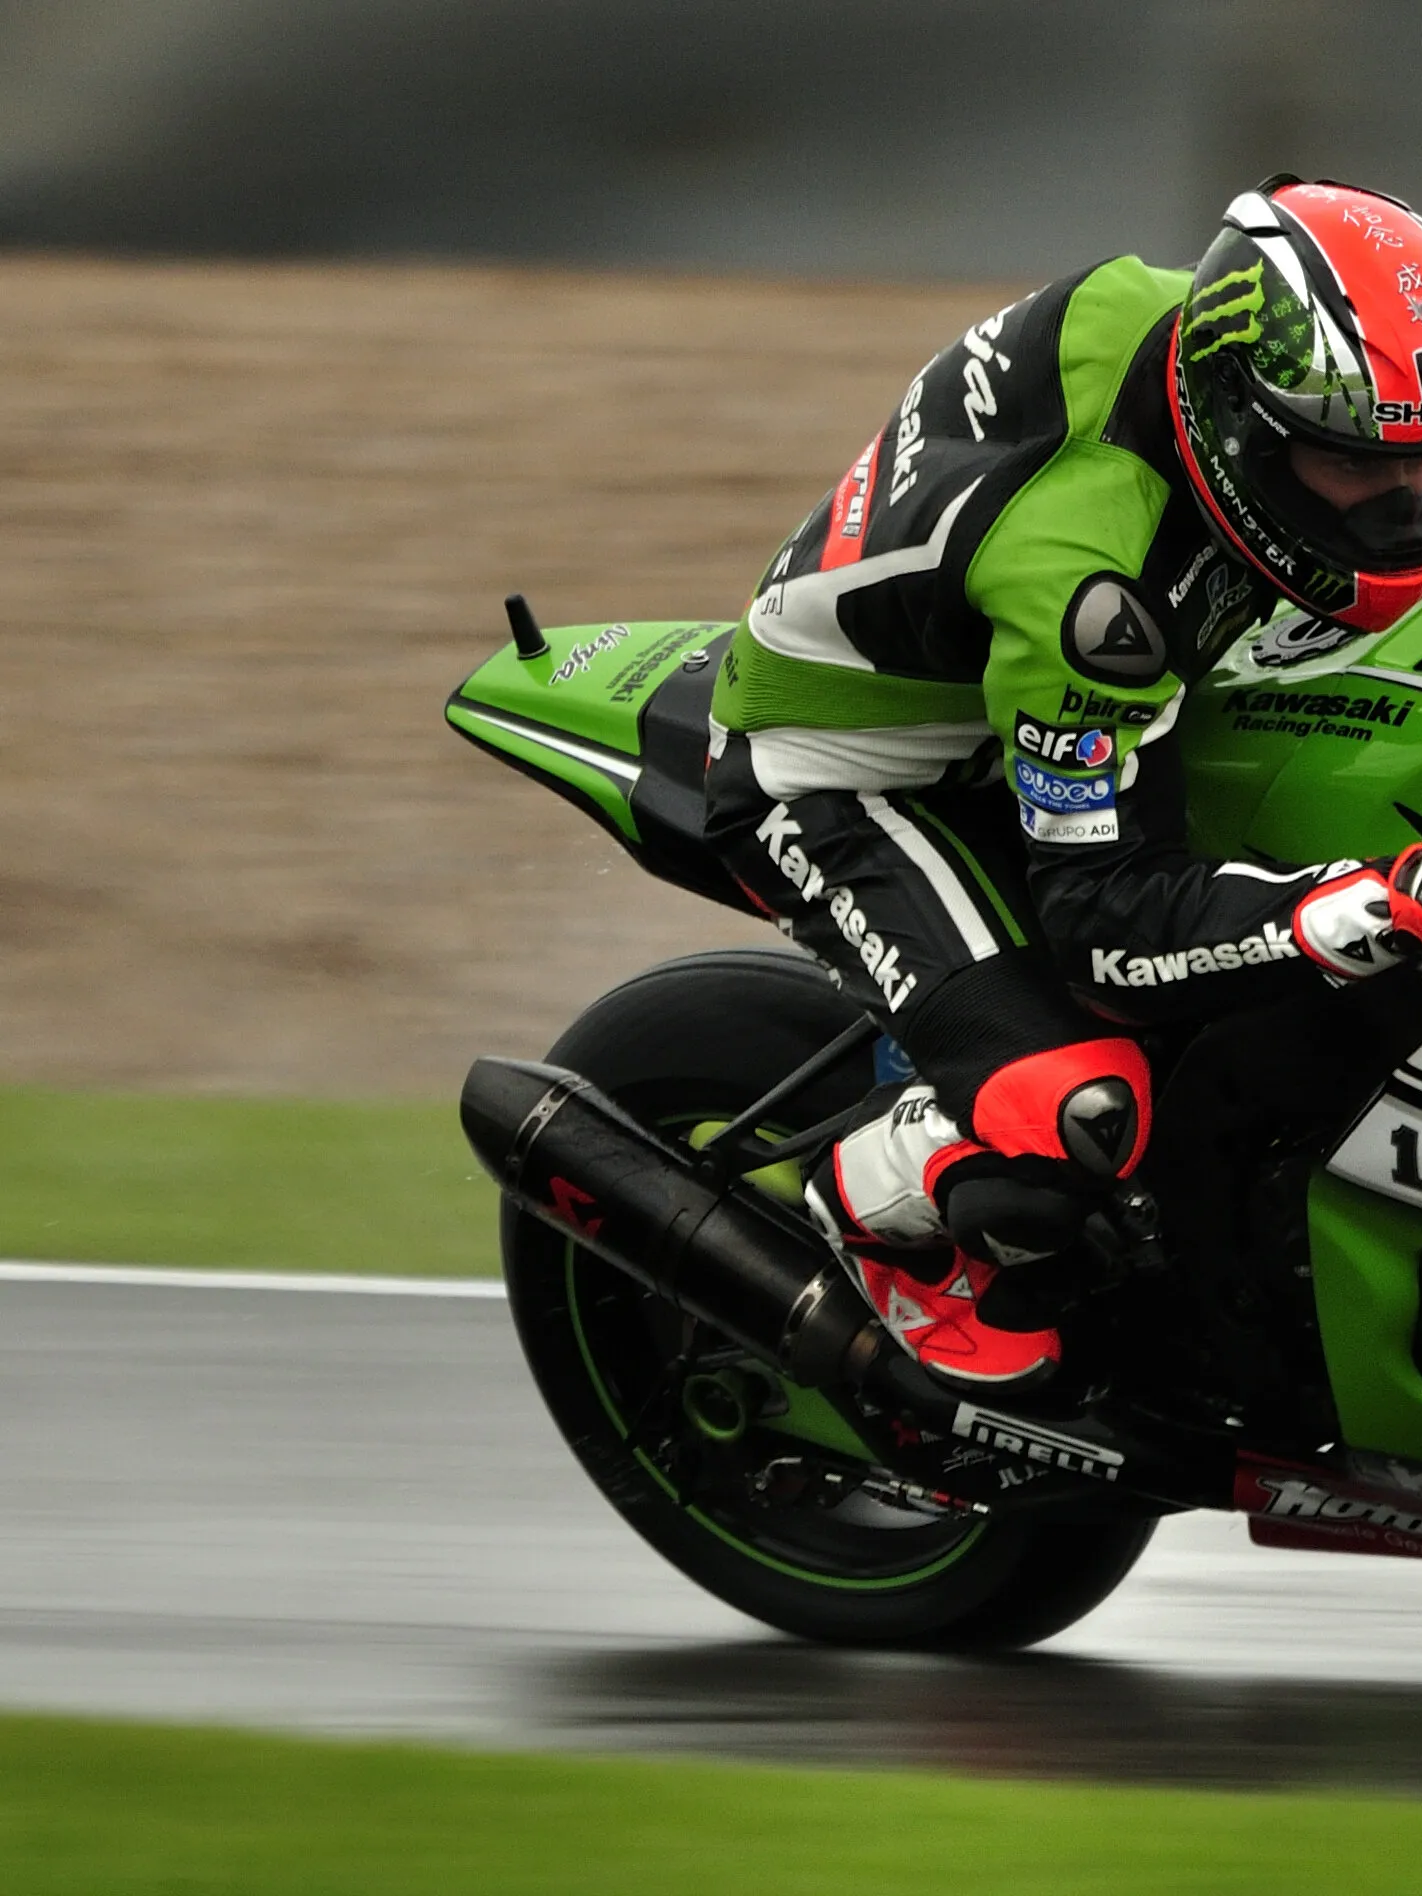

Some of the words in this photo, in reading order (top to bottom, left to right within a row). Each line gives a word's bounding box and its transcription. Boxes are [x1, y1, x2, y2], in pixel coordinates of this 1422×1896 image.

[1252, 401, 1290, 439] SHARK
[1222, 688, 1415, 727] Kawasaki
[1017, 723, 1077, 762] elf
[1232, 715, 1312, 738] Racing
[1311, 719, 1373, 742] Team
[1037, 825, 1086, 838] GRUPO
[1090, 823, 1116, 837] ADI
[1091, 921, 1301, 987] Kawasak
[951, 1400, 1126, 1482] PIRELLI
